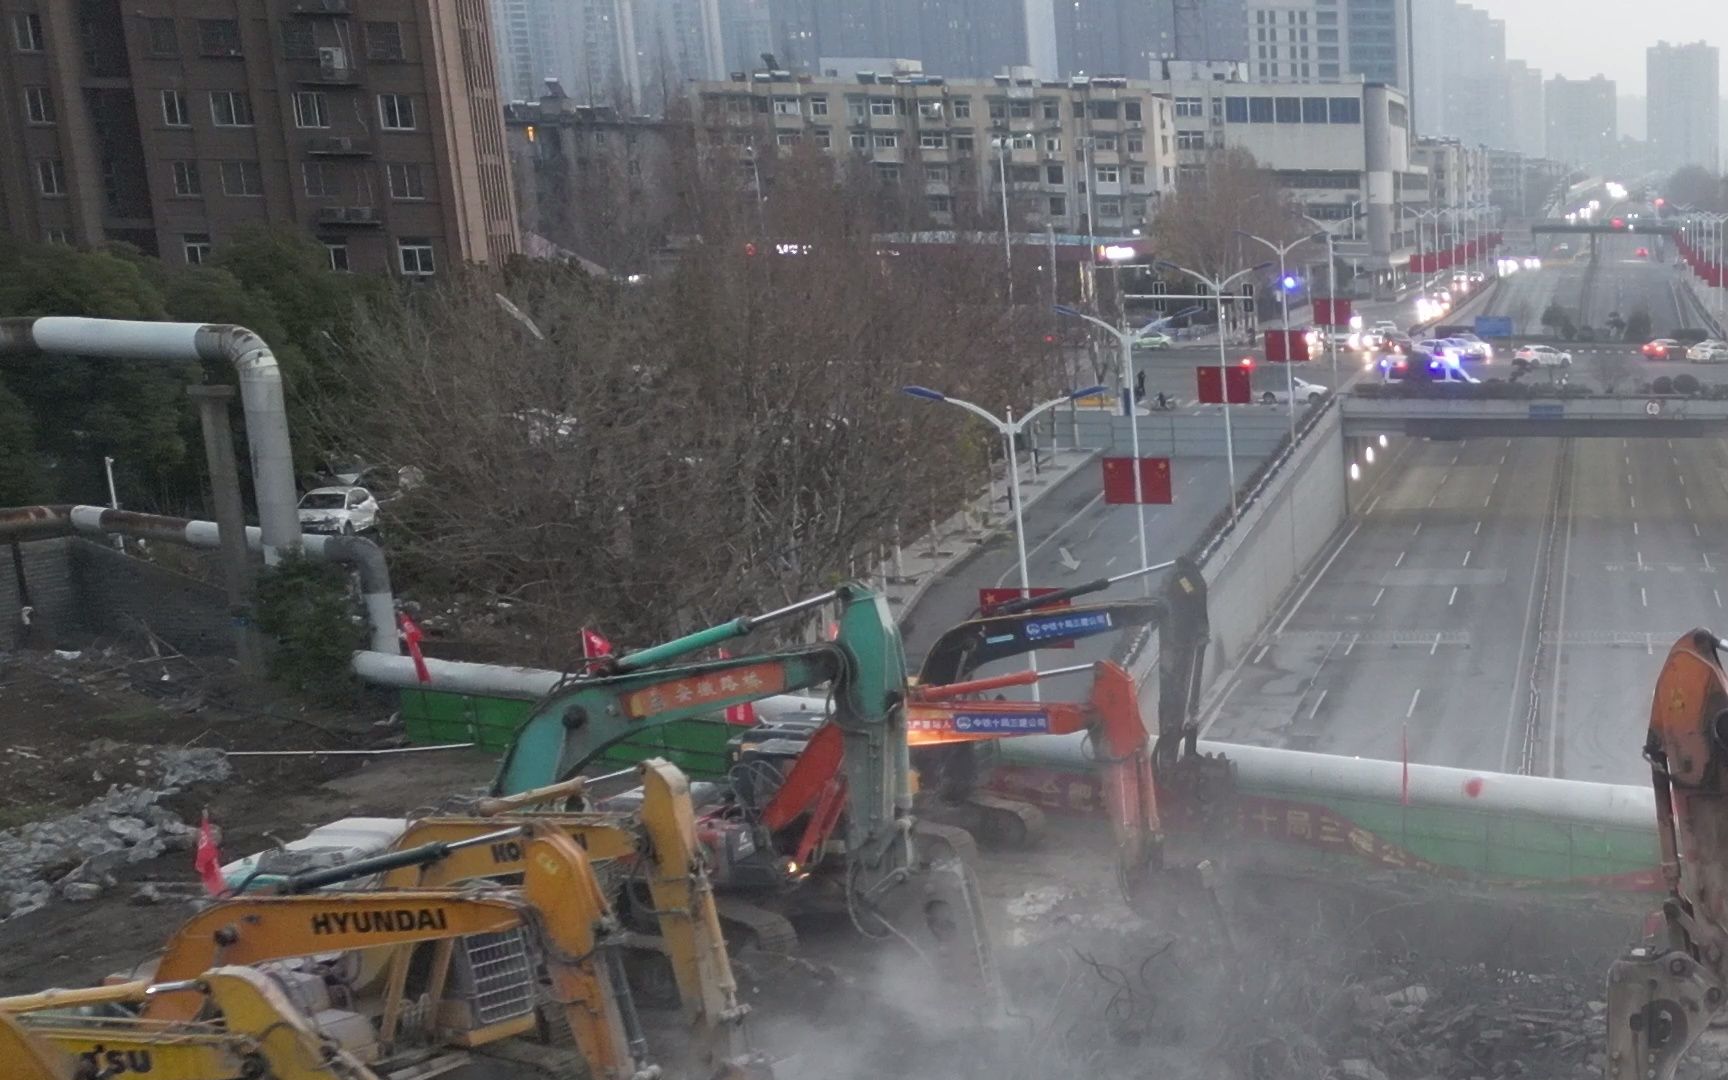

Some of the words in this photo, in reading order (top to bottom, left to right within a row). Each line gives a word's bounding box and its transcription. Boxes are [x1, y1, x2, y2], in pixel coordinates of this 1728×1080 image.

[973, 717, 1046, 729] 中铁十局三建公司
[312, 908, 448, 935] HYUNDAI
